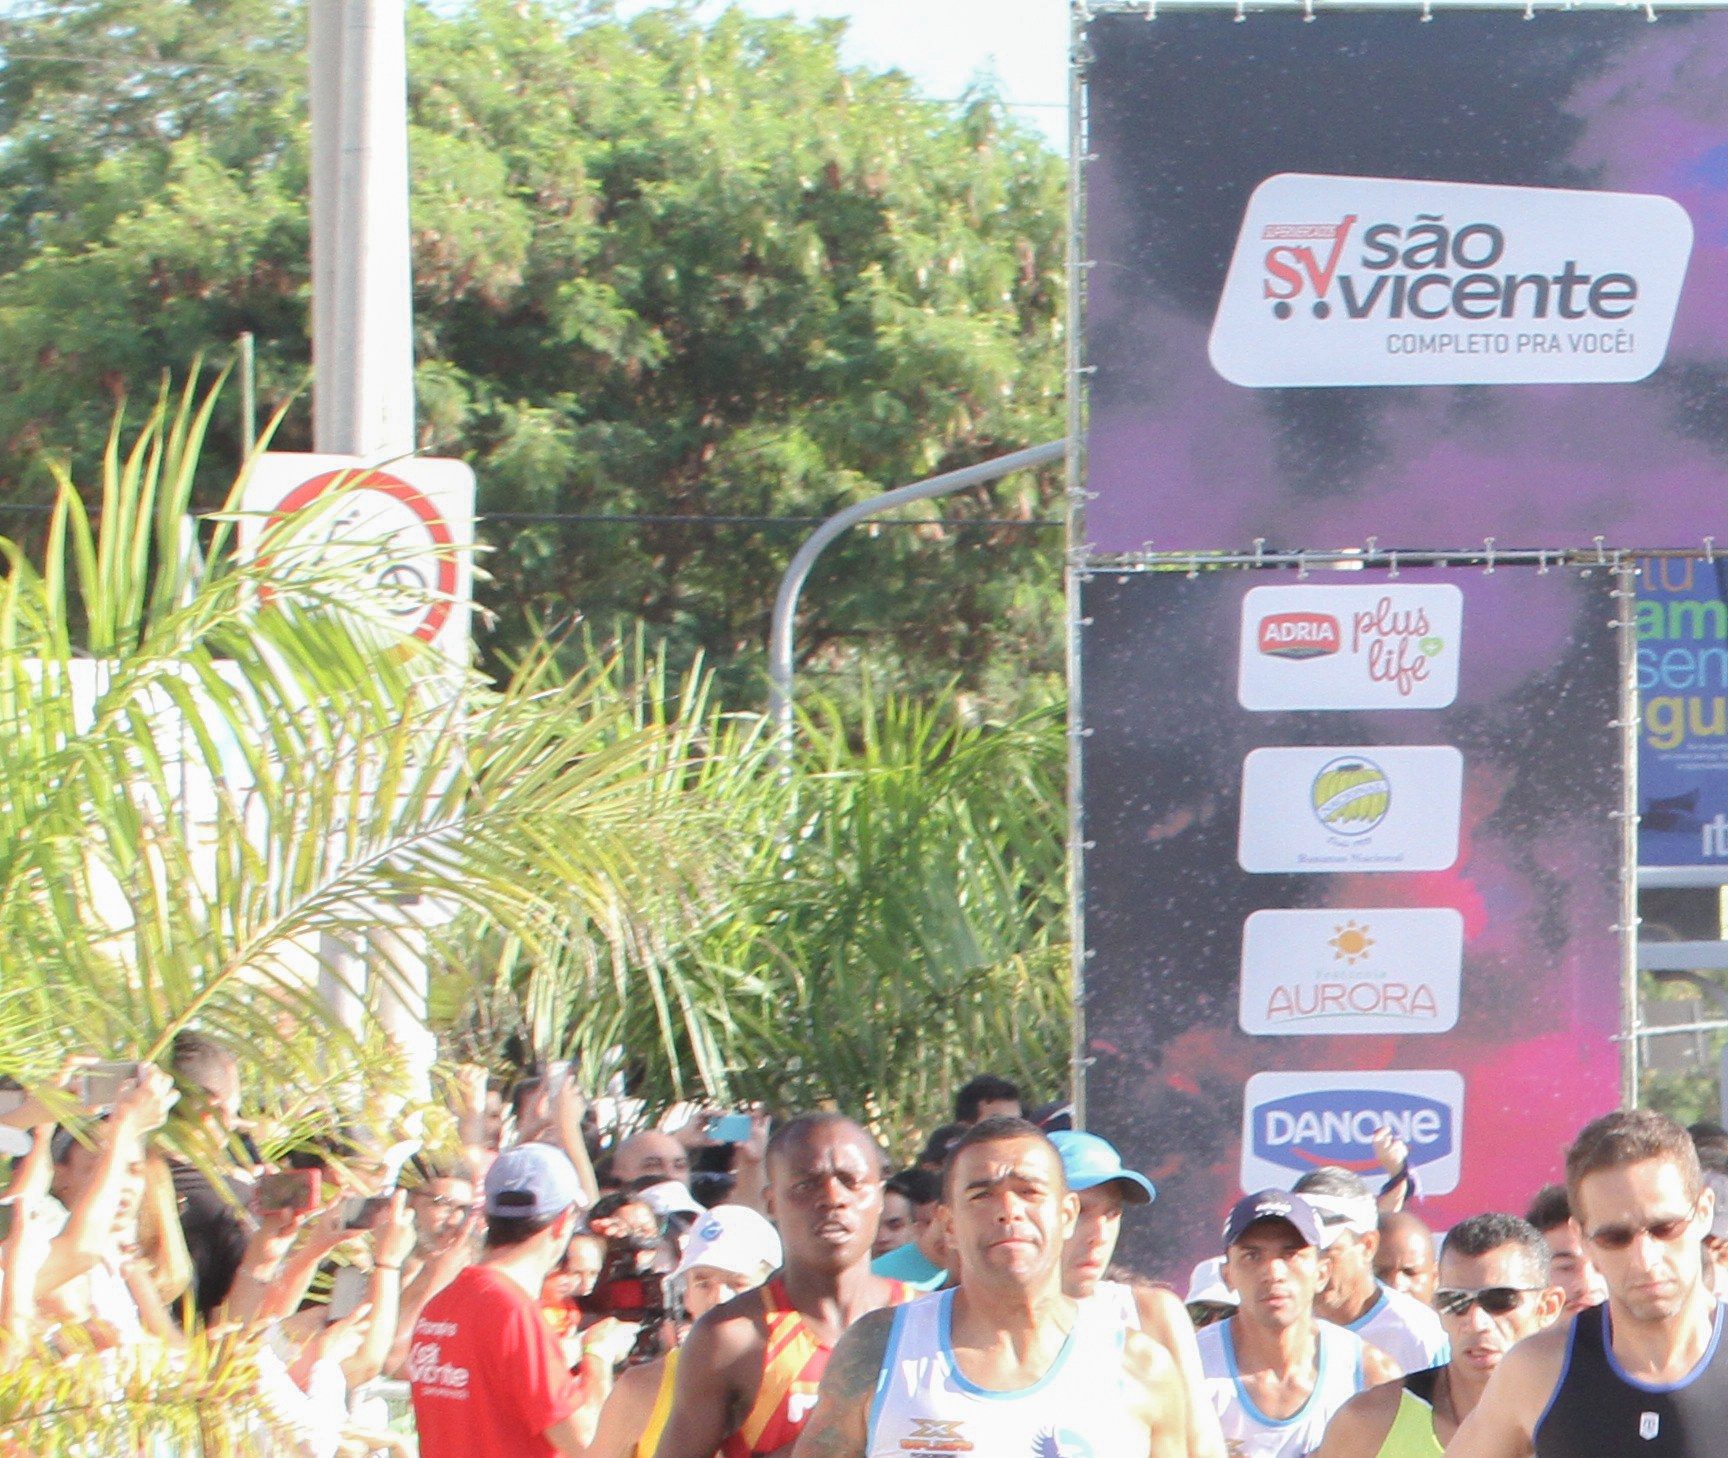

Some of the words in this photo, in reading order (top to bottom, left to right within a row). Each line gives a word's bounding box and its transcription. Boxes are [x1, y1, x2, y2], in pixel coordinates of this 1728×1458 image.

[1361, 213, 1504, 270] são
[1338, 261, 1638, 319] vicente
[1387, 333, 1509, 353] COMPLETO
[1517, 334, 1561, 353] PRA
[1569, 329, 1633, 353] VOCÊ!
[1263, 621, 1334, 642] ADRIA
[1354, 596, 1429, 653] plus
[1368, 636, 1429, 696] life
[1266, 982, 1439, 1020] AURORA
